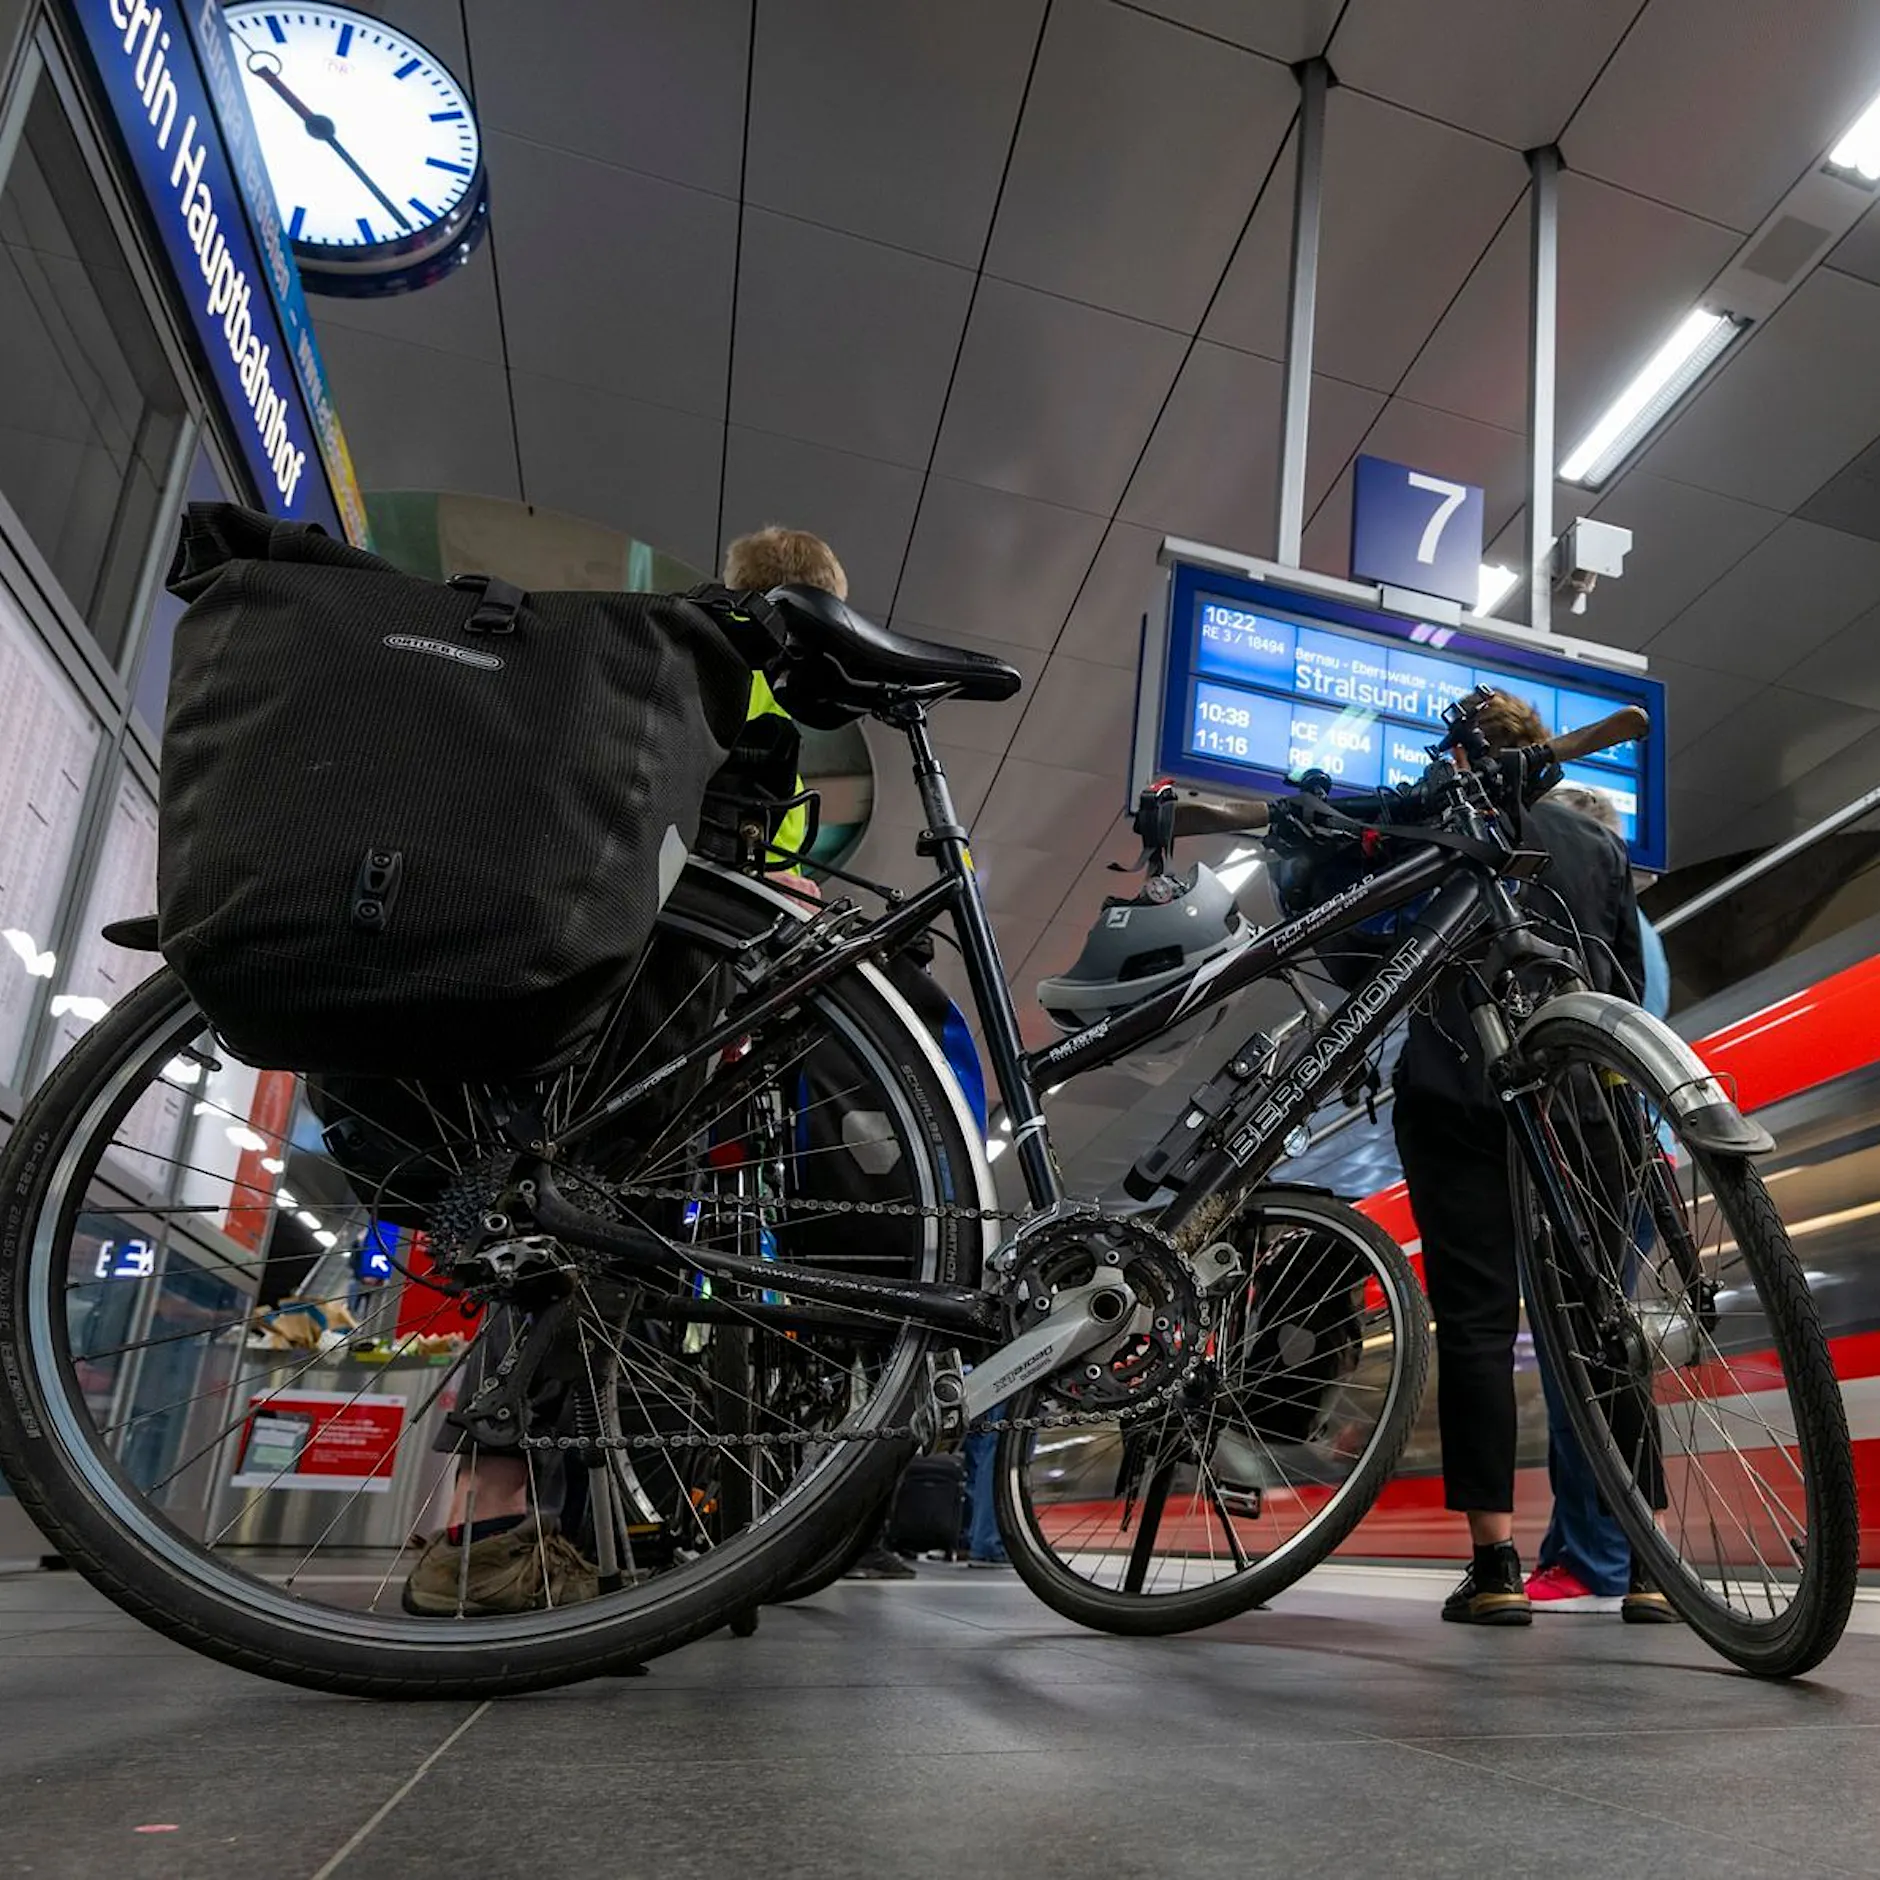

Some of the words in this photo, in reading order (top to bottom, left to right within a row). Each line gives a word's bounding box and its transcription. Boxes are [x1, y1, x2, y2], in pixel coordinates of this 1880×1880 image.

[171, 115, 306, 507] Hauptbahnhof
[1408, 471, 1467, 565] 7
[1202, 623, 1219, 641] RE
[1223, 628, 1233, 643] 3
[1204, 605, 1257, 633] 10:22
[1295, 664, 1419, 713] Stralsund
[1195, 728, 1248, 756] 11:16
[1321, 755, 1344, 775] 10
[1198, 701, 1250, 729] 10:38
[1291, 719, 1318, 743] ICE
[1328, 728, 1371, 754] 1604
[1393, 743, 1433, 766] Ham
[1224, 937, 1423, 1168] BERGAMONT
